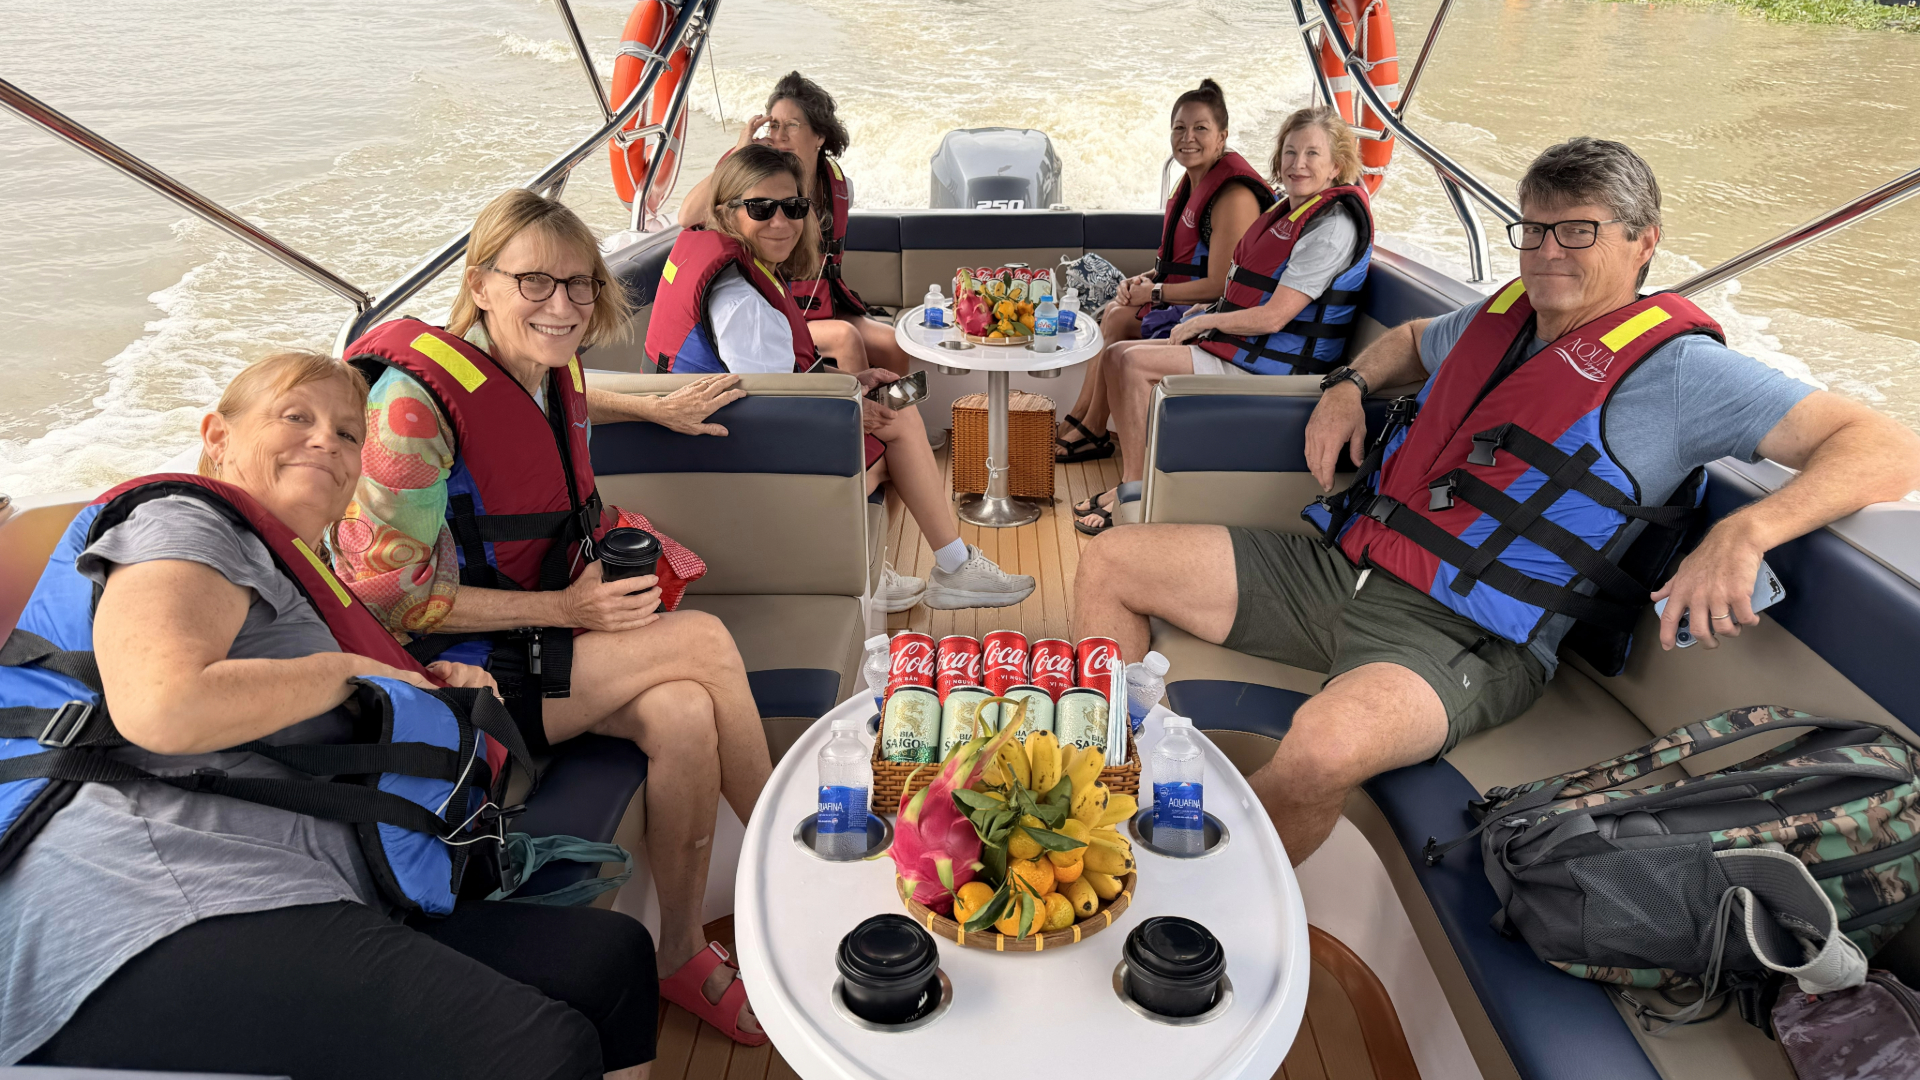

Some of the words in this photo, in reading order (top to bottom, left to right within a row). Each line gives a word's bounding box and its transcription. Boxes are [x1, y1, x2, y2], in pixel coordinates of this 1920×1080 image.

[976, 199, 1025, 210] 250
[1563, 337, 1615, 372] AQUA
[900, 730, 915, 738] BIA
[818, 801, 844, 813] QUAFINA
[1168, 797, 1202, 810] AQUAFINA
